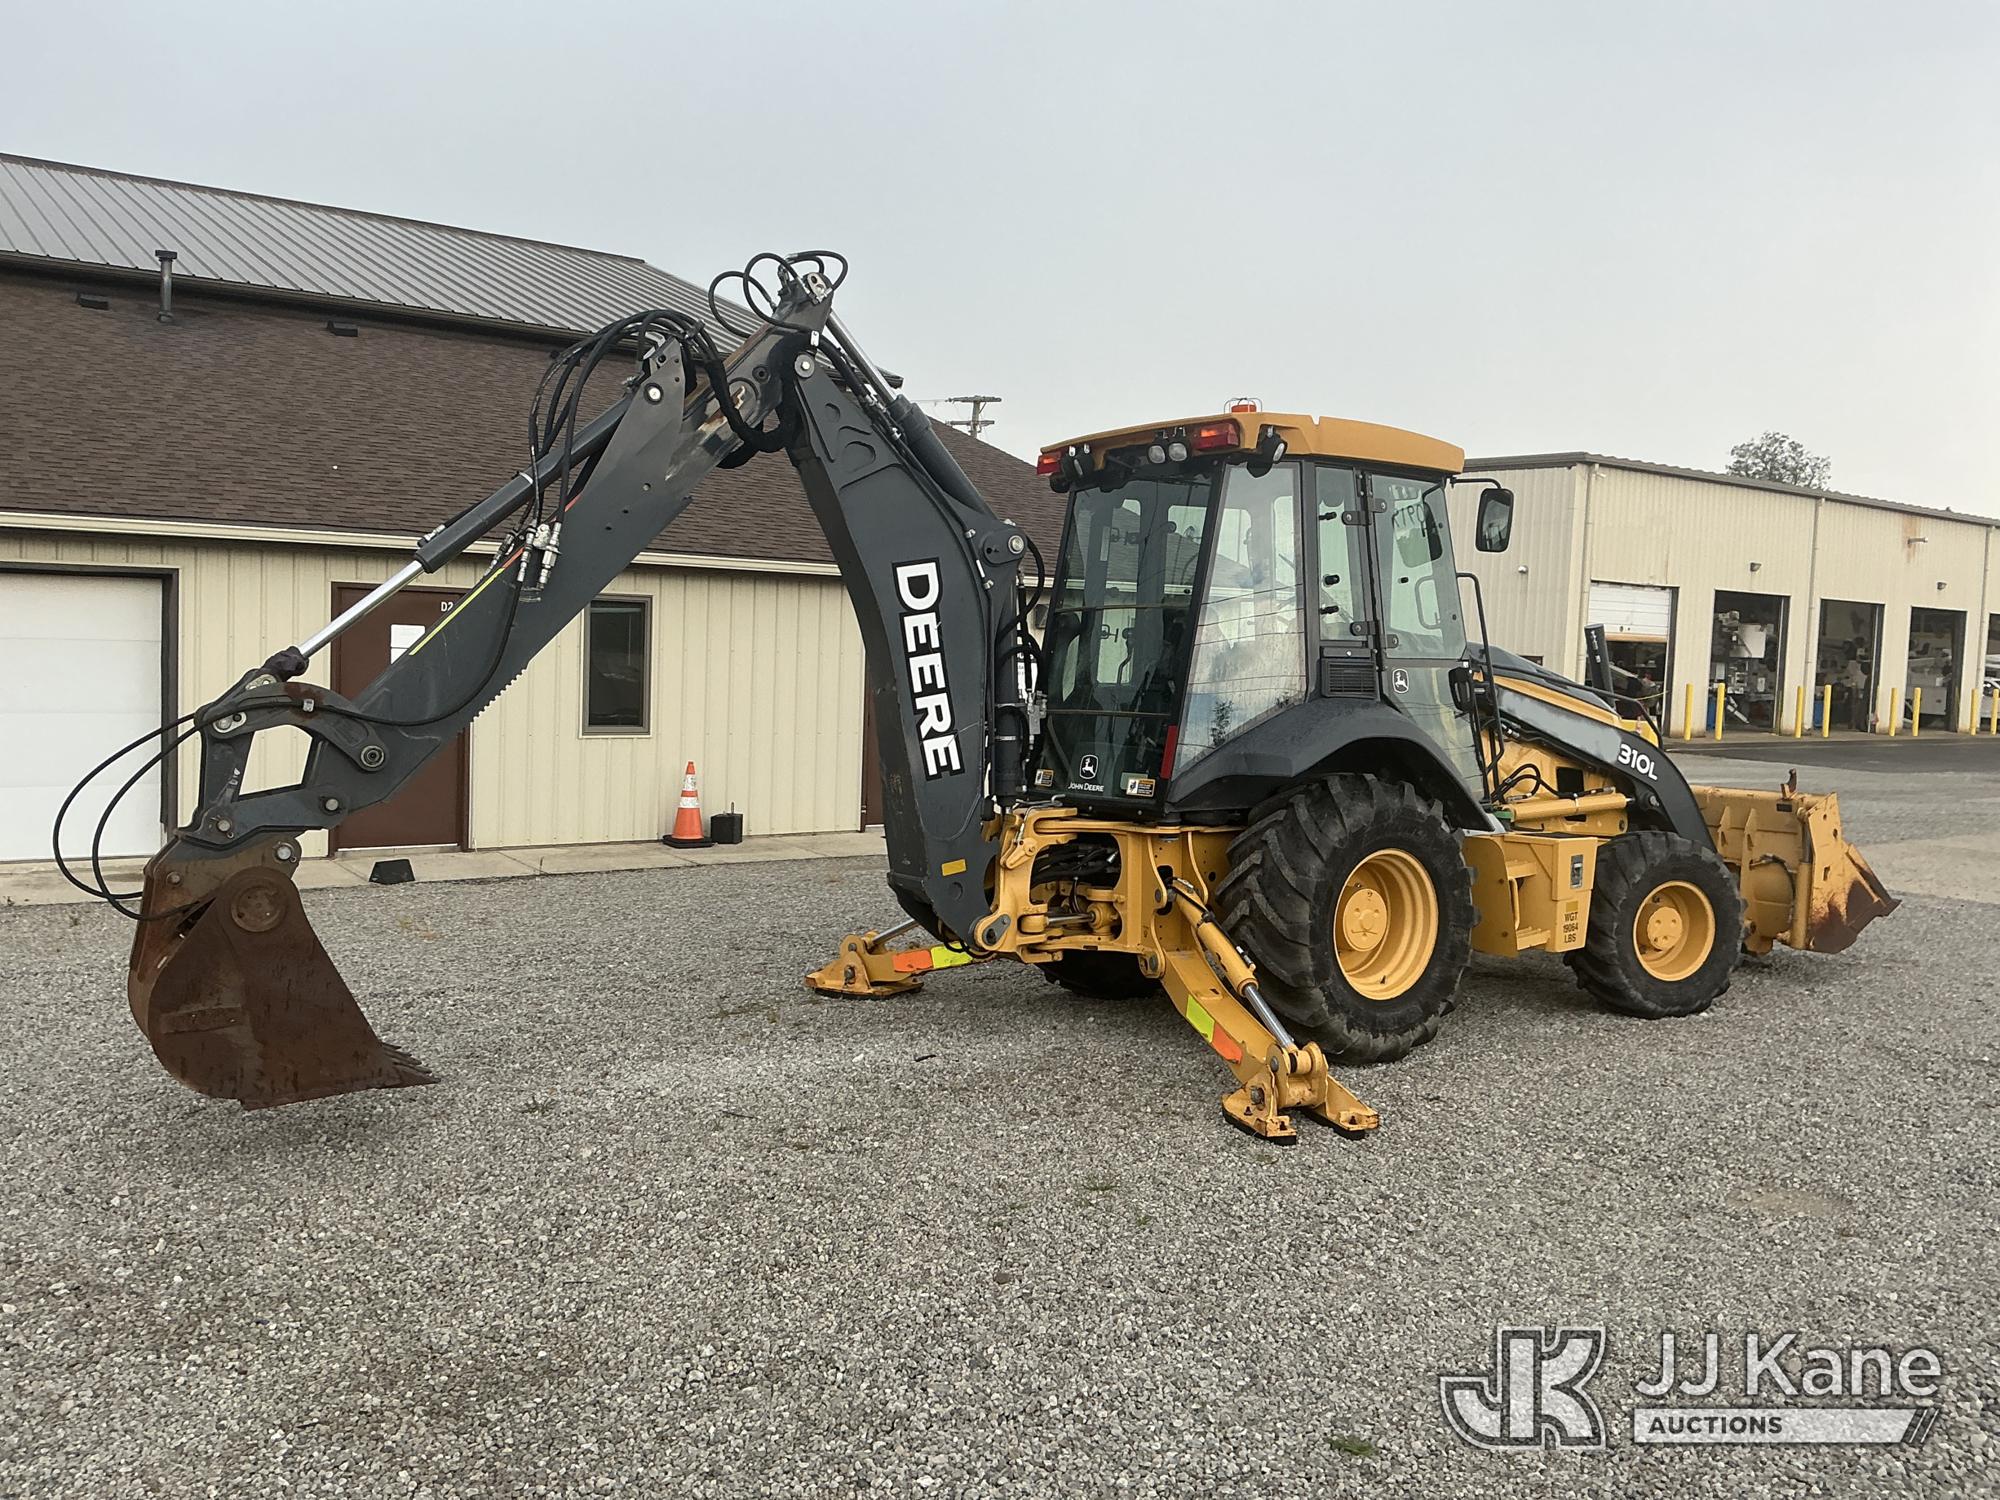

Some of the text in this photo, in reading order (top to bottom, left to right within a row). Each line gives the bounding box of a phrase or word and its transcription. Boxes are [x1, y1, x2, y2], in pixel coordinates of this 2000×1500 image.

[895, 561, 962, 778] DEERE
[1618, 743, 1658, 780] 310L
[1068, 782, 1104, 792] JOHN DEERE
[1564, 911, 1578, 922] WGT
[1564, 933, 1577, 943] LBS
